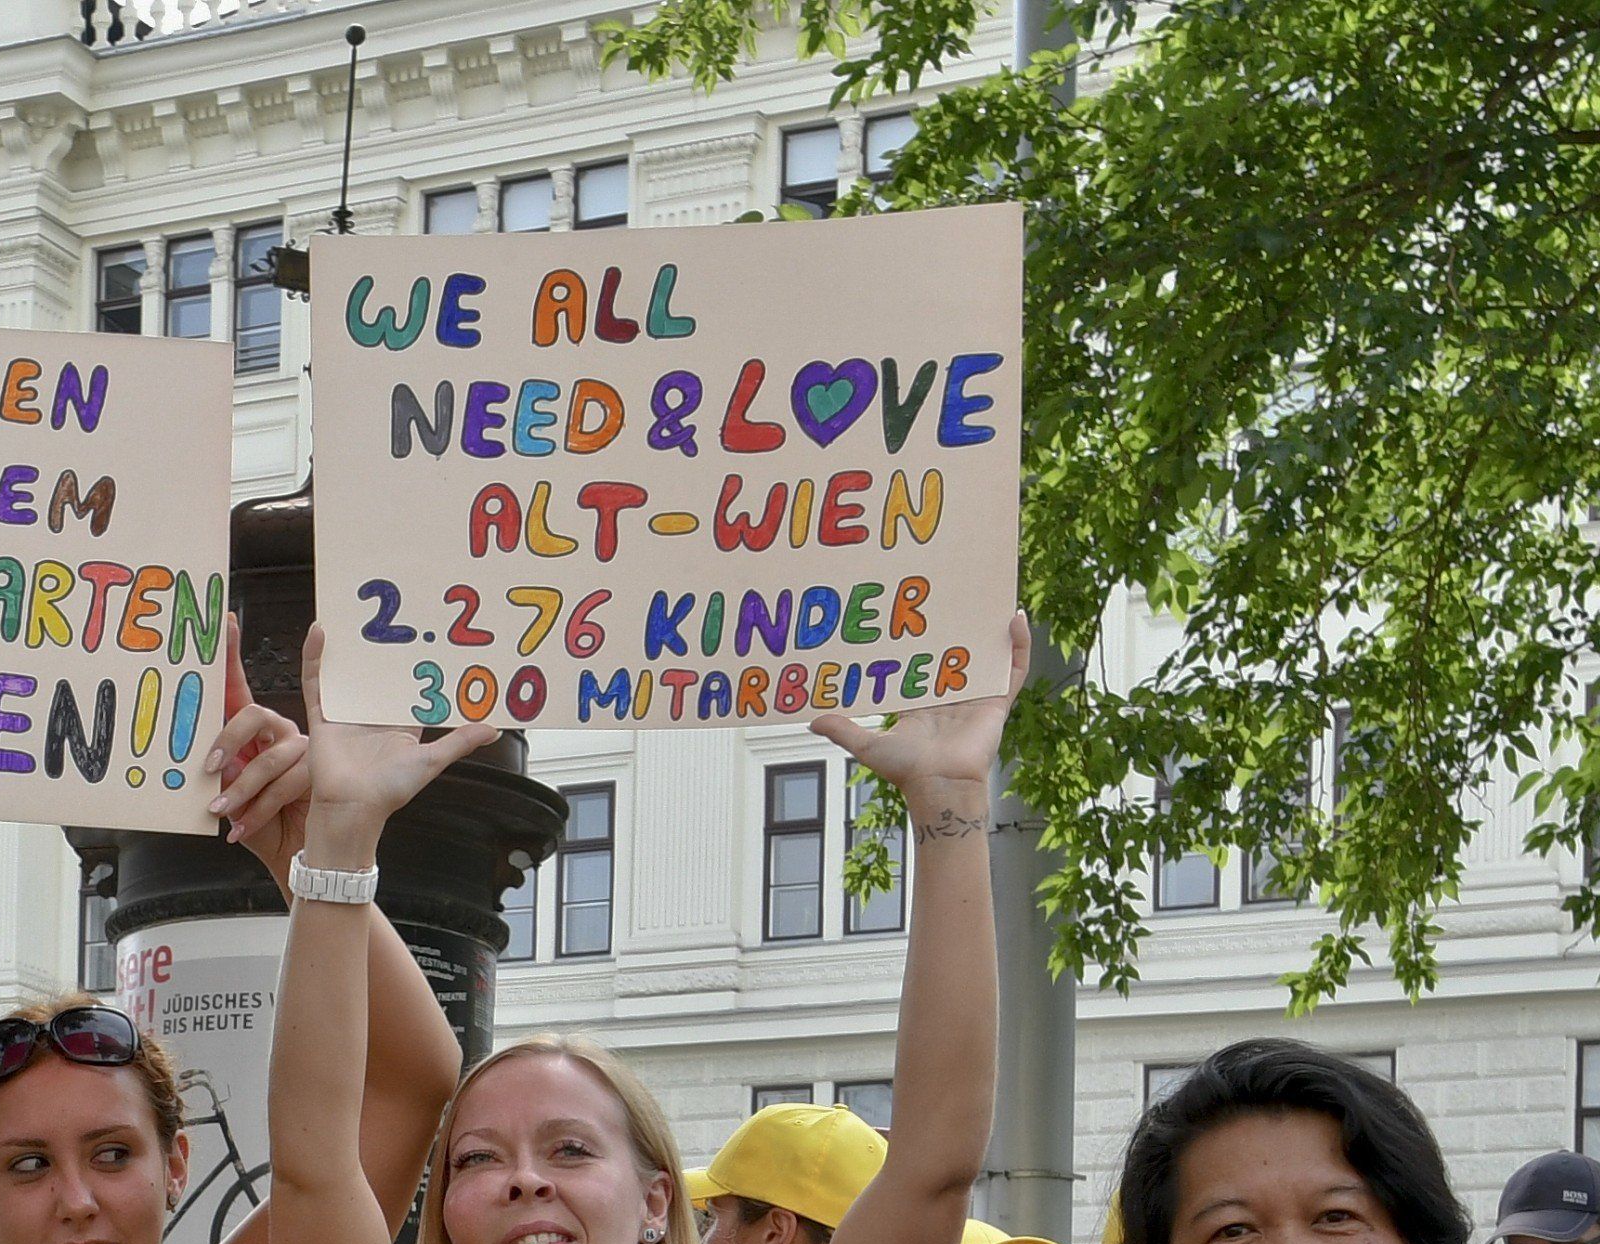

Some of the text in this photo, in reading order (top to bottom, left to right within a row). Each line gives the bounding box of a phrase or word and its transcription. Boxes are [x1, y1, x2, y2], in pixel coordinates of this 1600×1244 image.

[346, 264, 696, 351] WE ALL
[391, 379, 625, 459] NEED
[469, 468, 943, 563] ALT-WIEN
[358, 576, 930, 660] 2.276 KINDER
[411, 647, 969, 724] 300 MITARBEITER
[162, 991, 262, 1015] JÜDISCHES
[163, 1013, 254, 1035] BIS HEUTE
